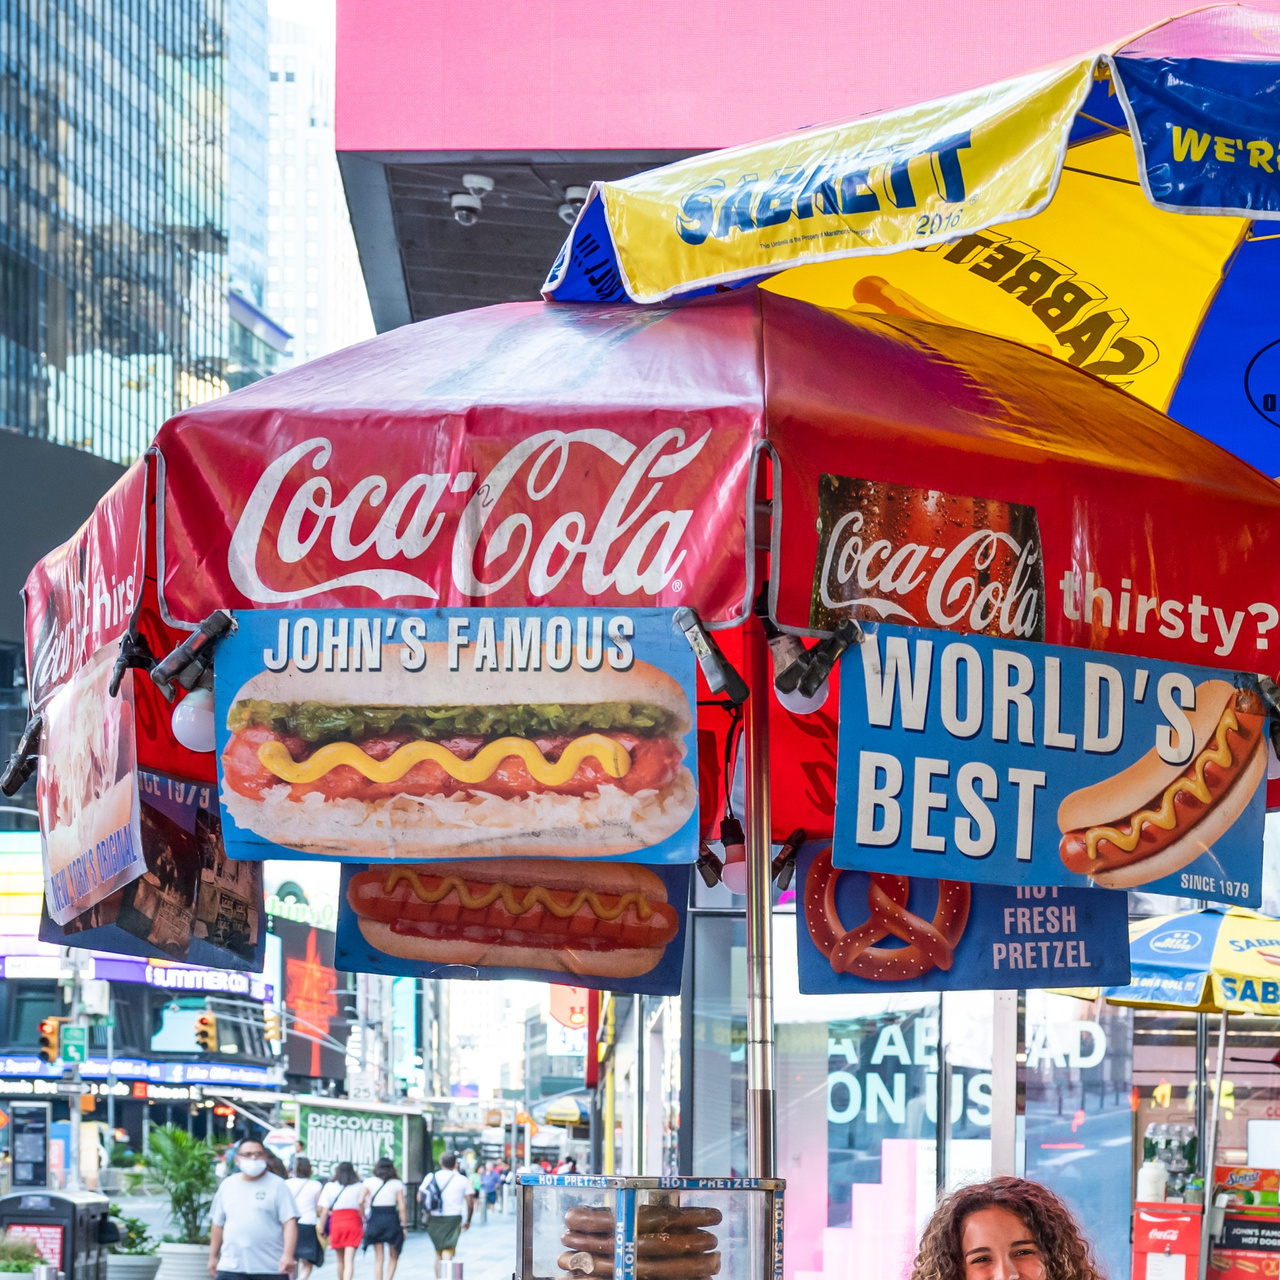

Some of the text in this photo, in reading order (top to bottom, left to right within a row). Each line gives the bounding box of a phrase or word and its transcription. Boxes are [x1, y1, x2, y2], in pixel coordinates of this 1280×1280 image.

[676, 129, 971, 246] SABRETT
[916, 209, 963, 236] 2016
[227, 427, 711, 600] Coca-Cola
[820, 511, 1041, 637] Coca-Cola
[1060, 569, 1279, 657] thirsty?
[262, 615, 636, 671] JOHN'S FAMOUS
[859, 635, 1197, 766] WORLD'S
[855, 750, 1047, 861] BEST
[51, 868, 71, 912] NEW
[96, 823, 137, 883] ORIGINAL
[1180, 873, 1249, 898] SINCE 1979
[1004, 906, 1077, 934] FRESH
[993, 941, 1092, 970] PRETZEL
[827, 1072, 993, 1126] ON US
[307, 1112, 395, 1132] DISCOVER
[307, 1126, 395, 1161] BROADWAY'S
[539, 1175, 559, 1186] HOT
[661, 1177, 759, 1188] HOT PRETZEL
[775, 1198, 784, 1234] HOT
[1232, 1227, 1259, 1237] JOHN'S
[624, 1241, 634, 1276] HOT
[1241, 1237, 1258, 1246] HOT
